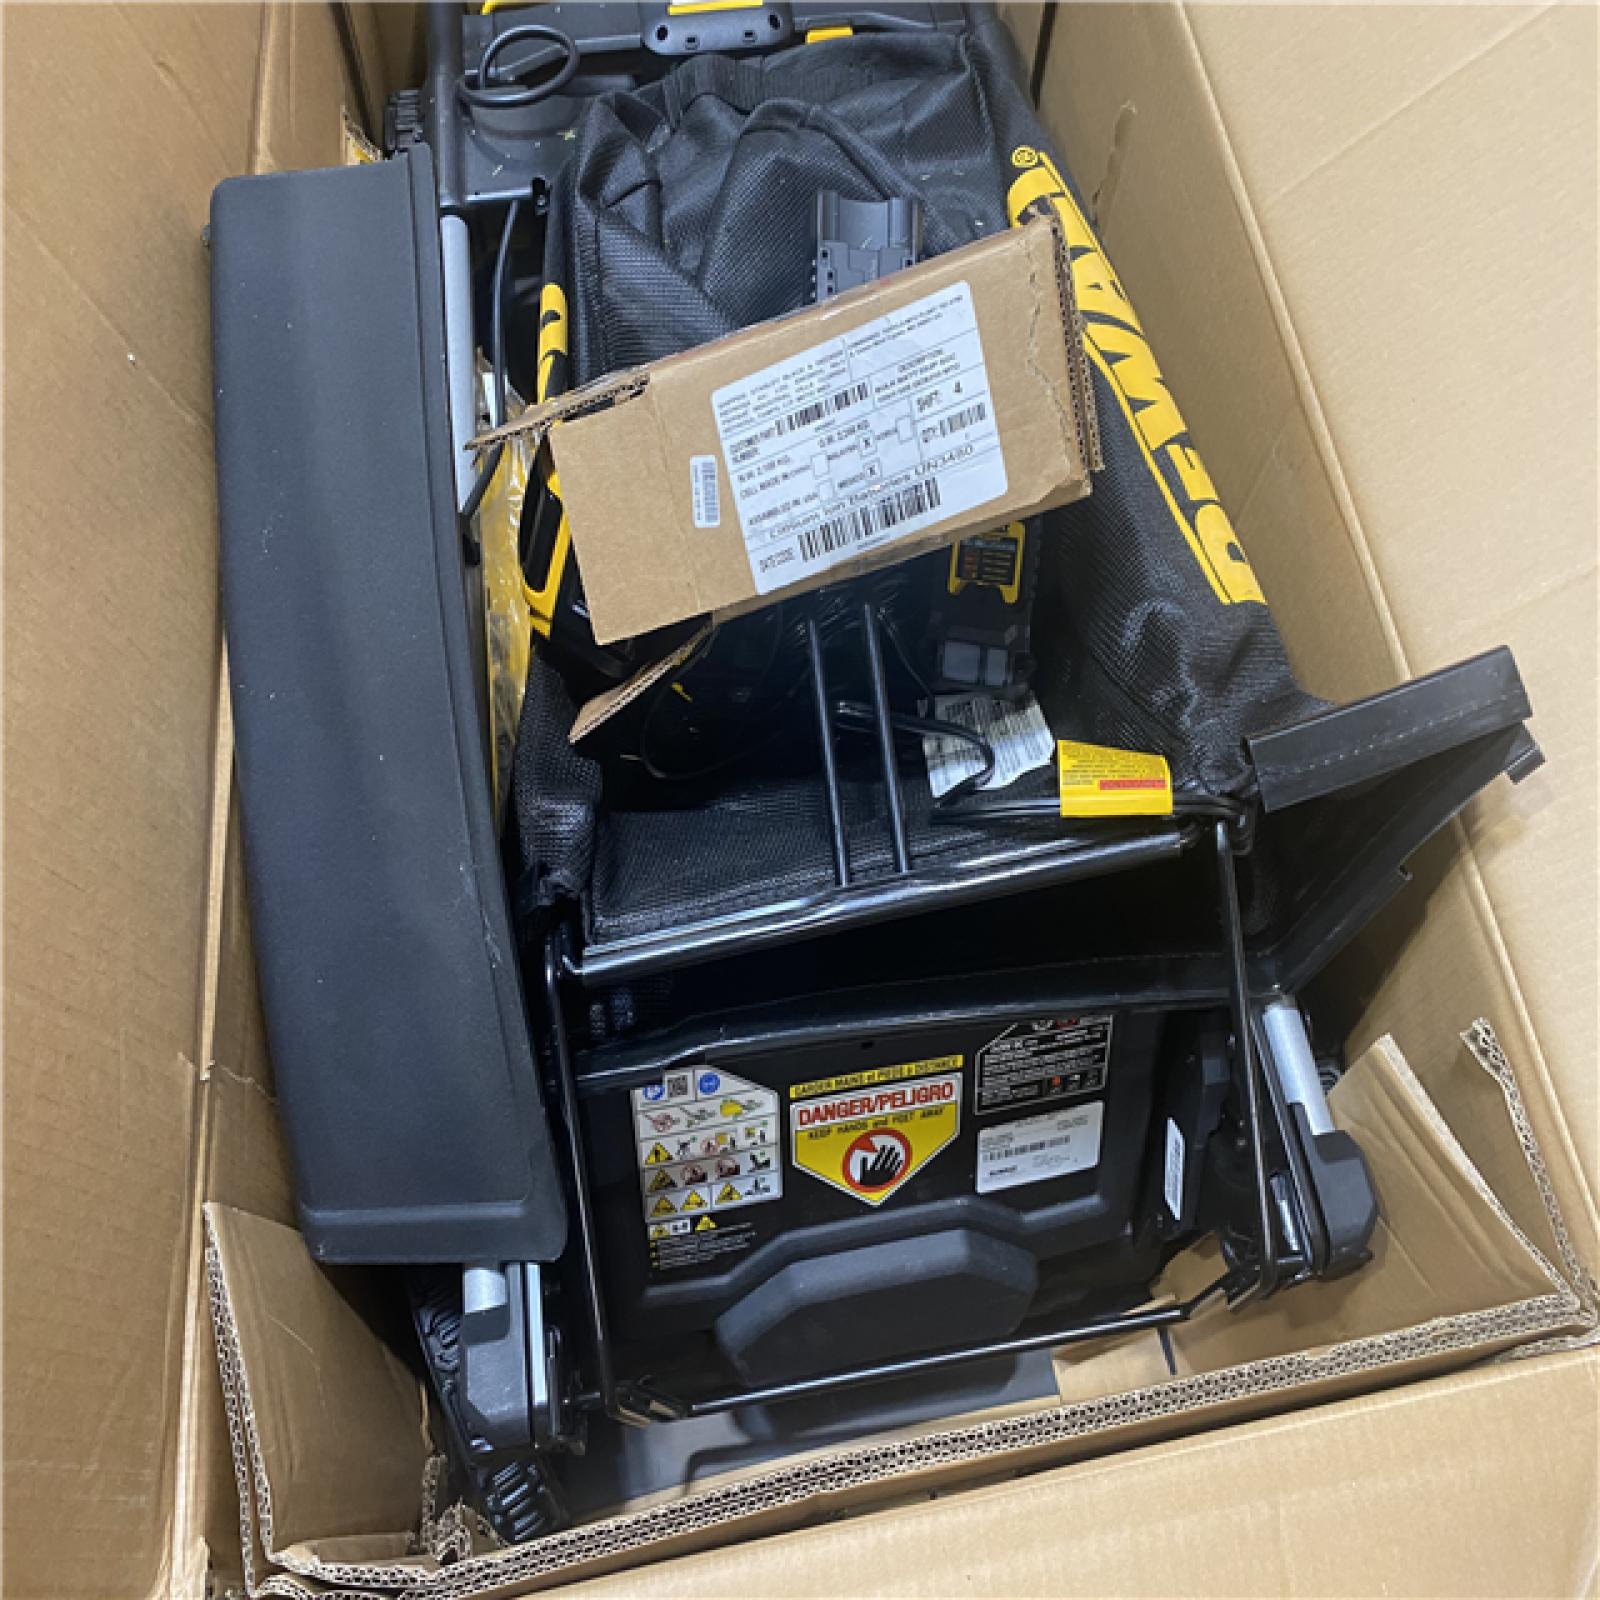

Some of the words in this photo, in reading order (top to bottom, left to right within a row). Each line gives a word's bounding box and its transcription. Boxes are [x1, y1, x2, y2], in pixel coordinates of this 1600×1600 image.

[799, 1082, 954, 1126] DANGER/PELIGRO
[807, 1129, 832, 1140] KEEP
[837, 1122, 868, 1135] HANDS
[892, 1113, 915, 1124] FEET
[920, 1107, 944, 1118] AWAY
